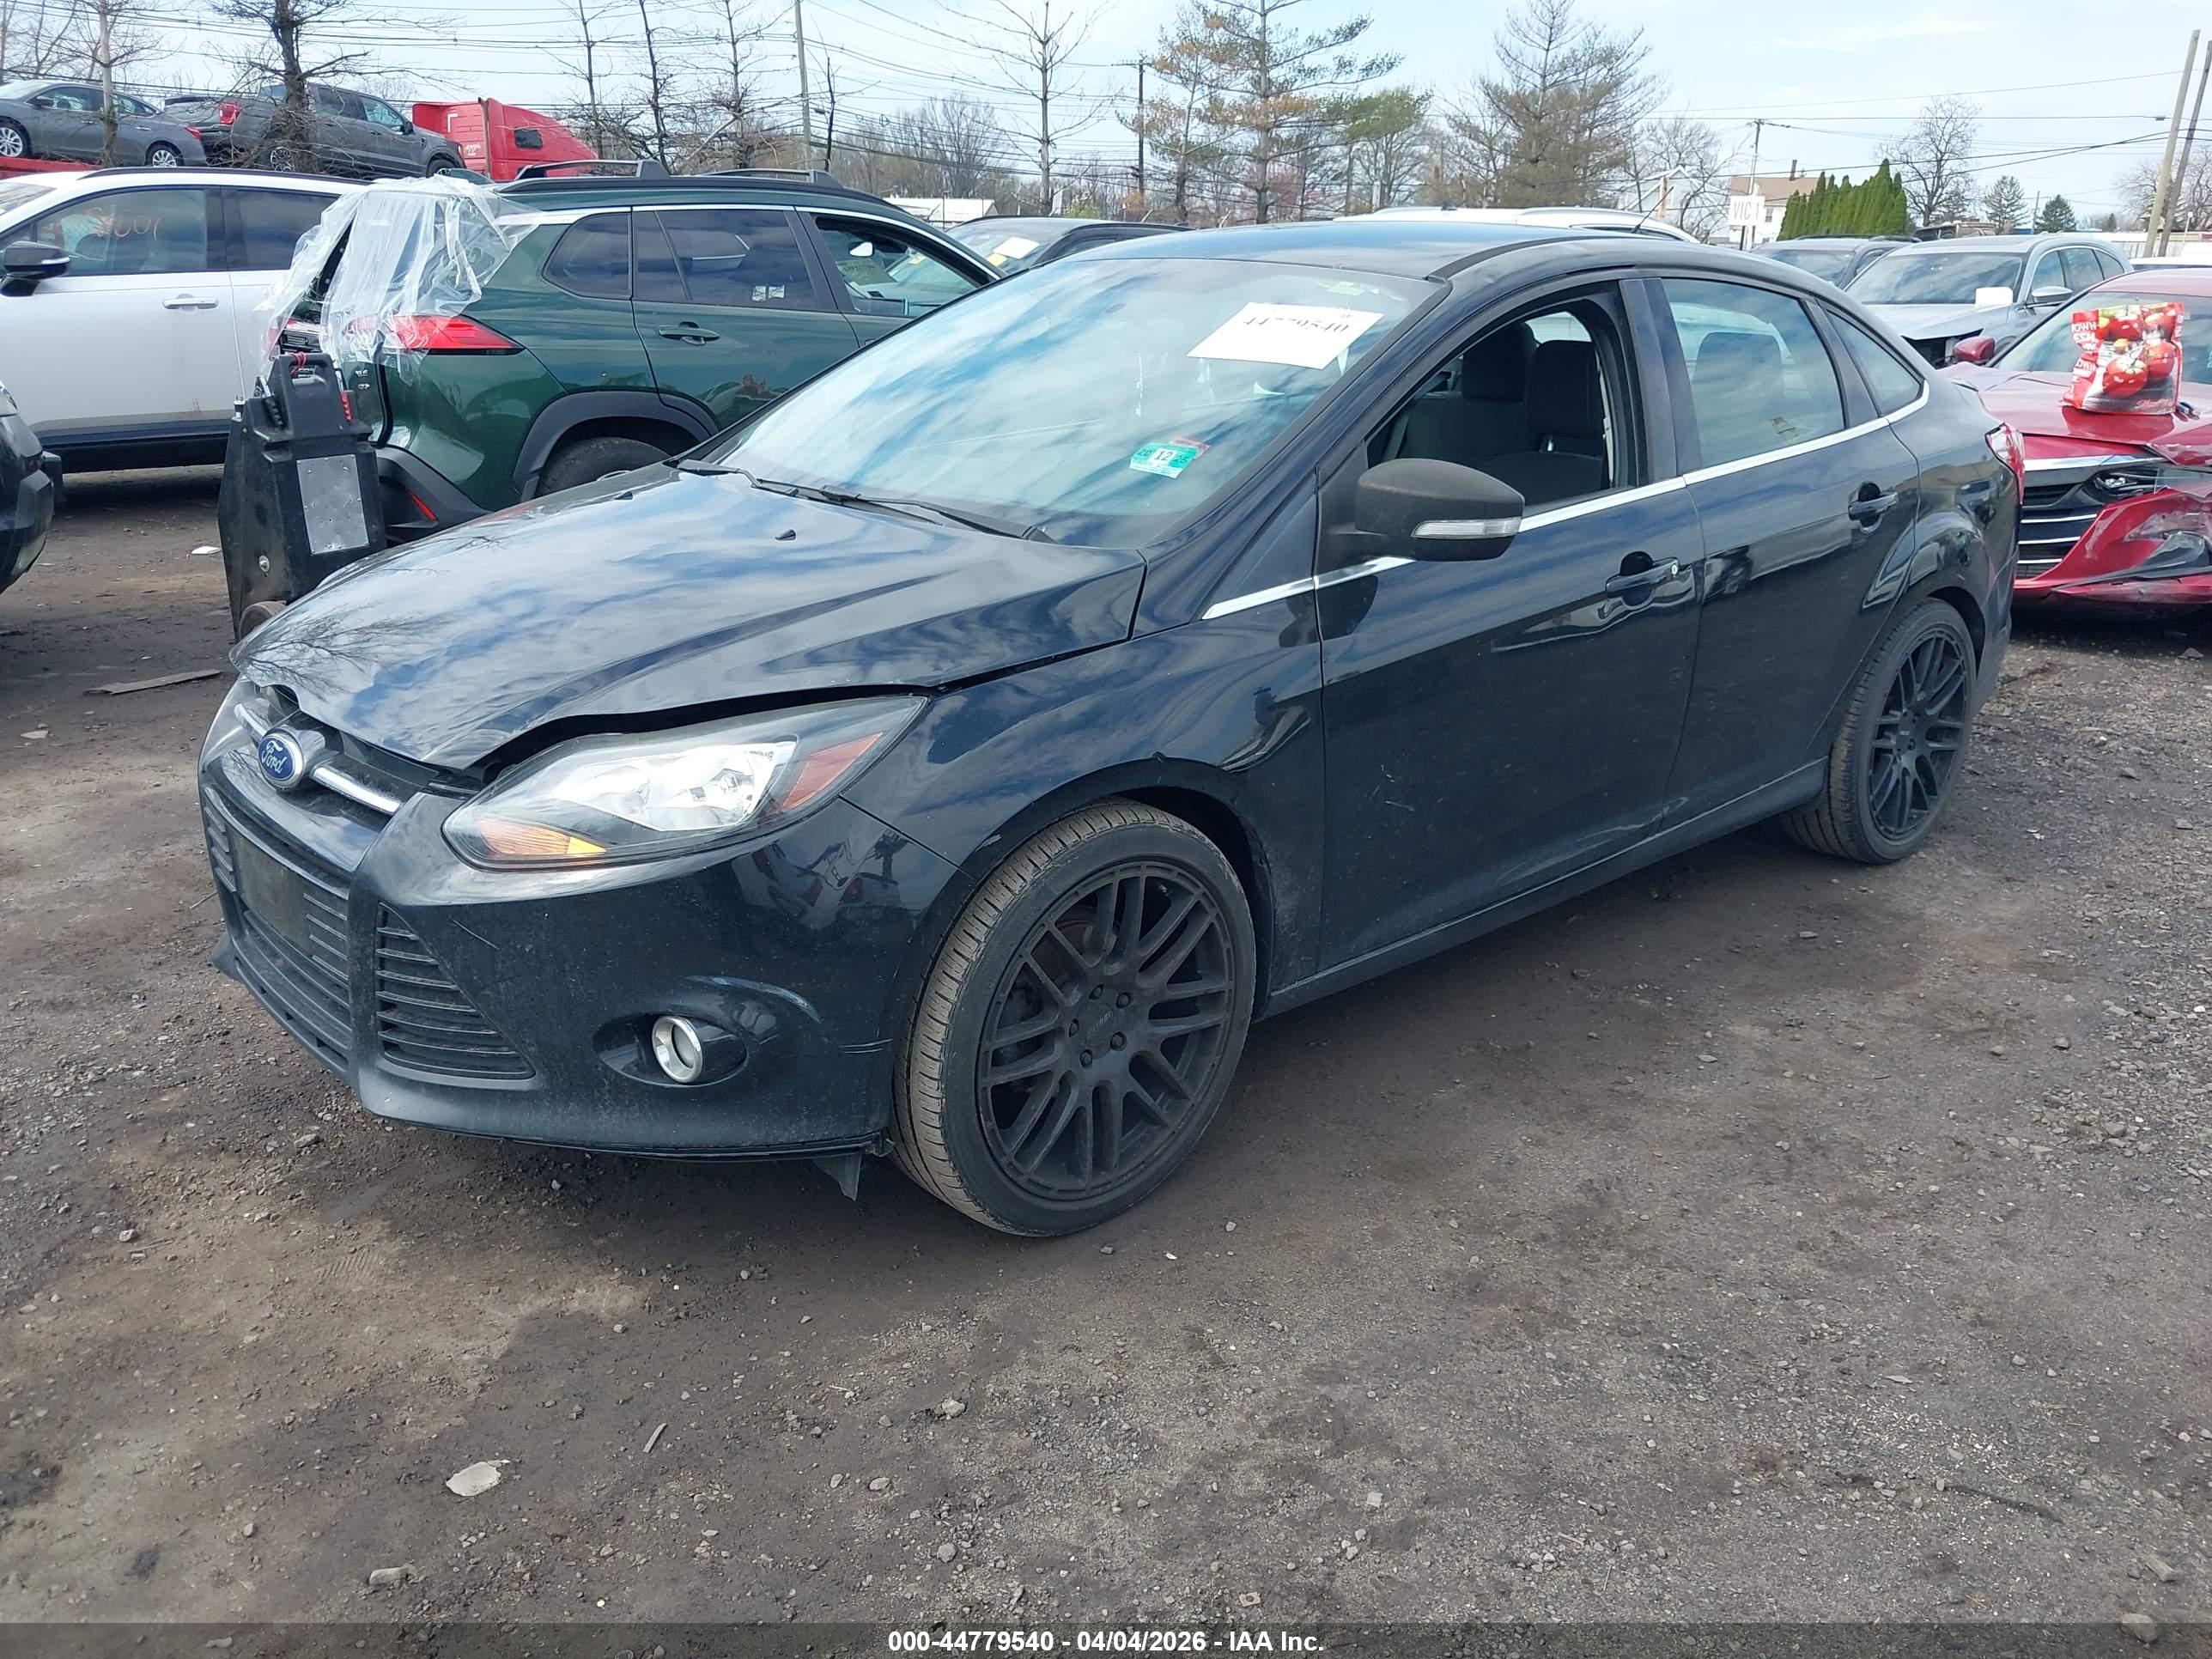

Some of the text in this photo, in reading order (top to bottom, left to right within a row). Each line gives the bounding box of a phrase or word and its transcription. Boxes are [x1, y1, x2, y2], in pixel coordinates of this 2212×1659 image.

[1154, 451, 1174, 461] 12
[1171, 454, 1190, 464] 25
[261, 740, 288, 774] Ford
